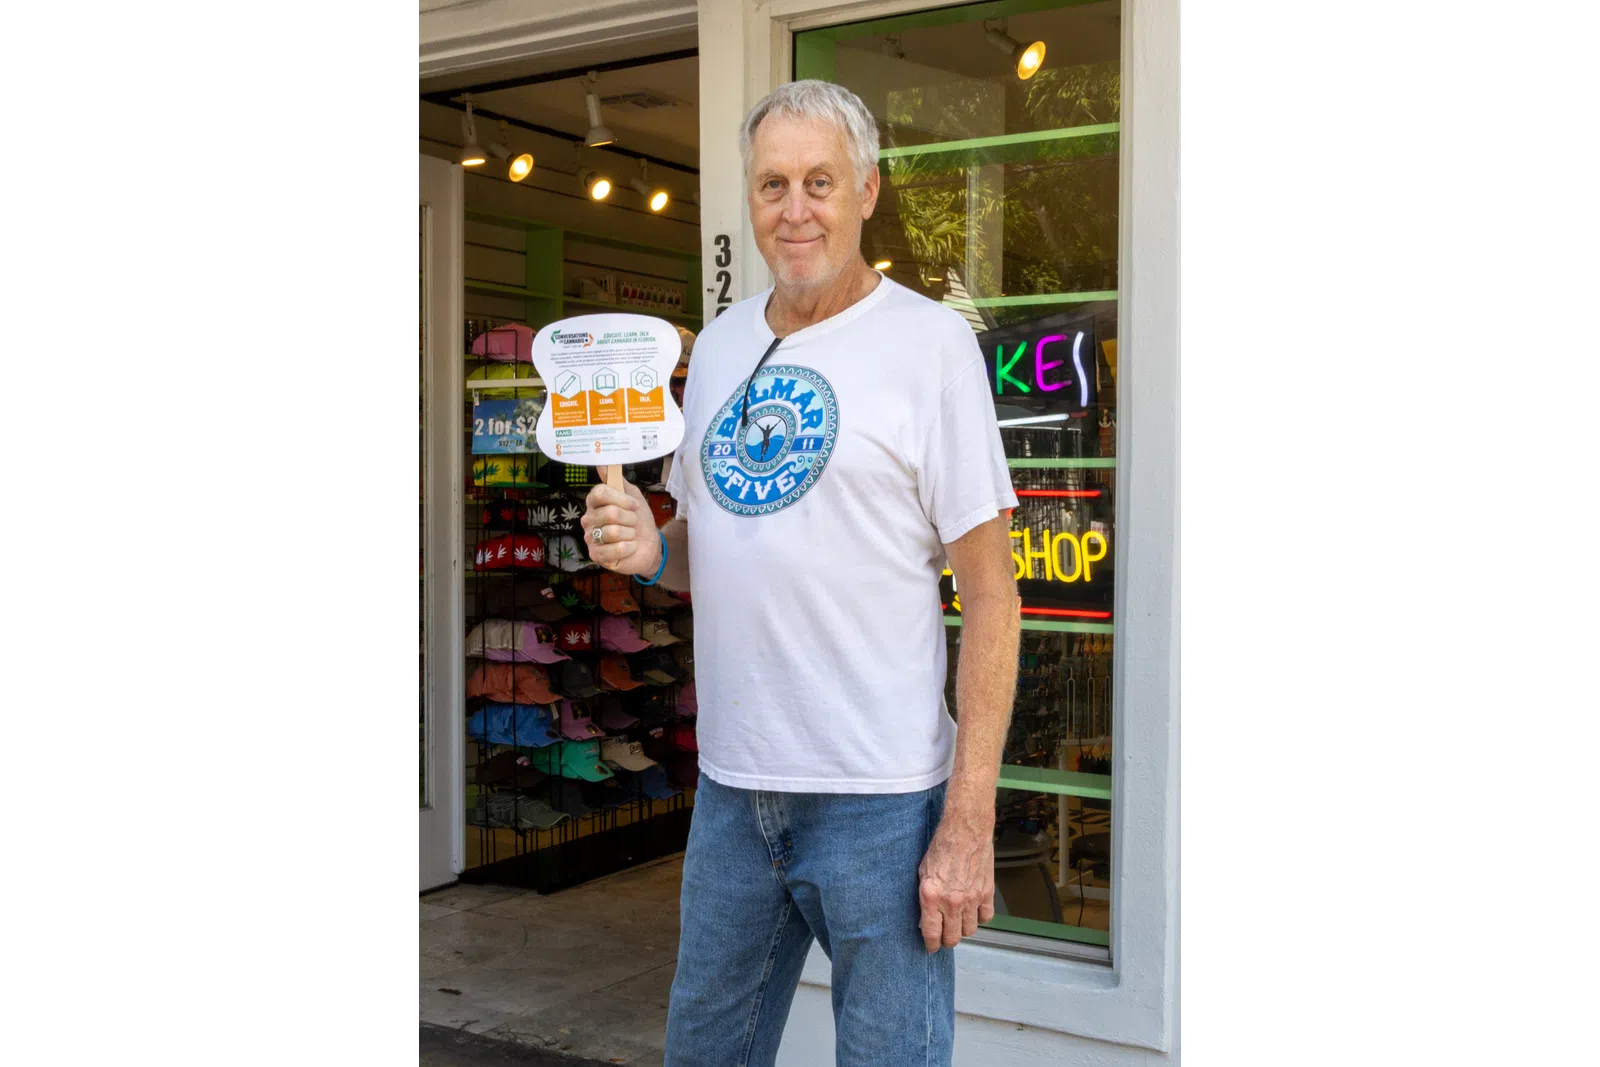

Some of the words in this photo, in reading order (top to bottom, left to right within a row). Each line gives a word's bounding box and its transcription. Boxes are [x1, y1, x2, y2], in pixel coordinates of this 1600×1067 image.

[714, 234, 733, 318] 32
[995, 333, 1073, 395] KE
[474, 418, 484, 436] 2
[488, 417, 512, 436] for
[516, 416, 536, 436] $2
[715, 377, 824, 440] BELMAR
[712, 444, 731, 456] 20
[724, 469, 796, 500] FIVE
